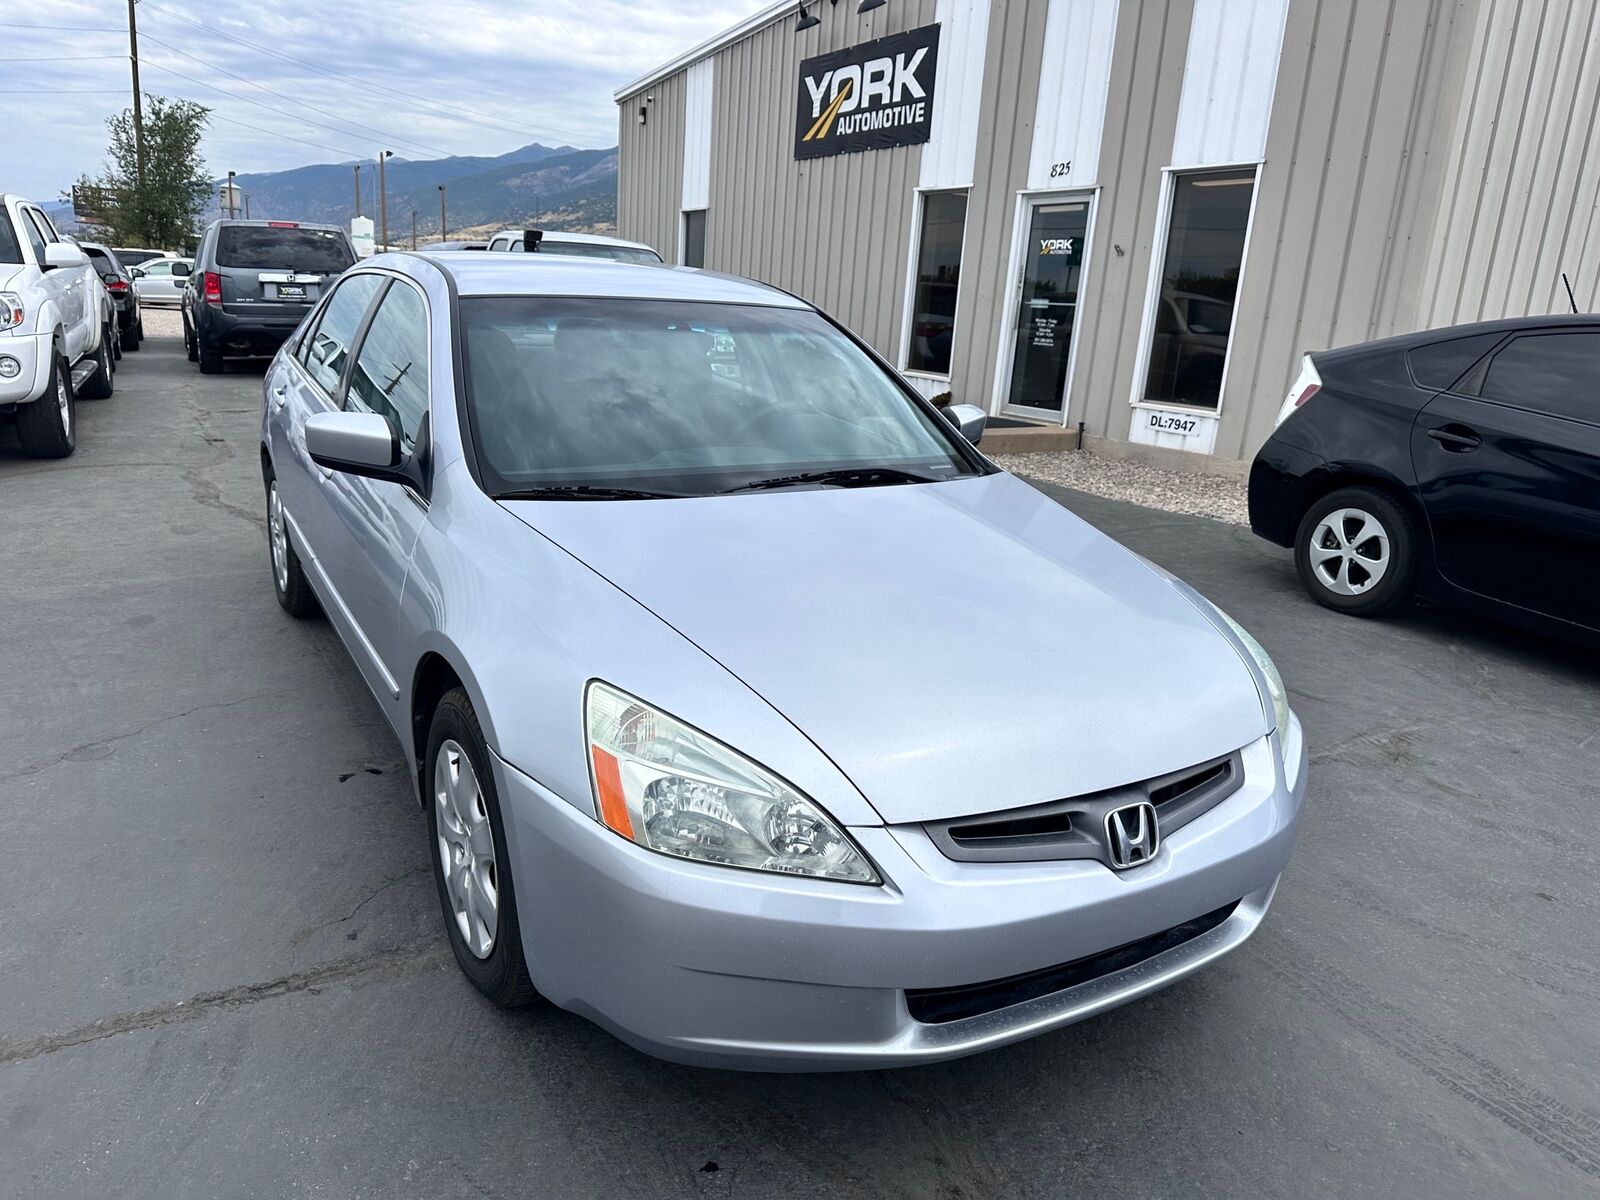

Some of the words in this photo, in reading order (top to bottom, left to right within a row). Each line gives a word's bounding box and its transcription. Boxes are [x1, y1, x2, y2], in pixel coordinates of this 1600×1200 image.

[804, 46, 930, 118] YORK
[836, 102, 926, 136] AUTOMOTIVE
[1050, 160, 1072, 178] 825
[1040, 238, 1073, 250] YORK
[1150, 415, 1196, 432] DL:7947
